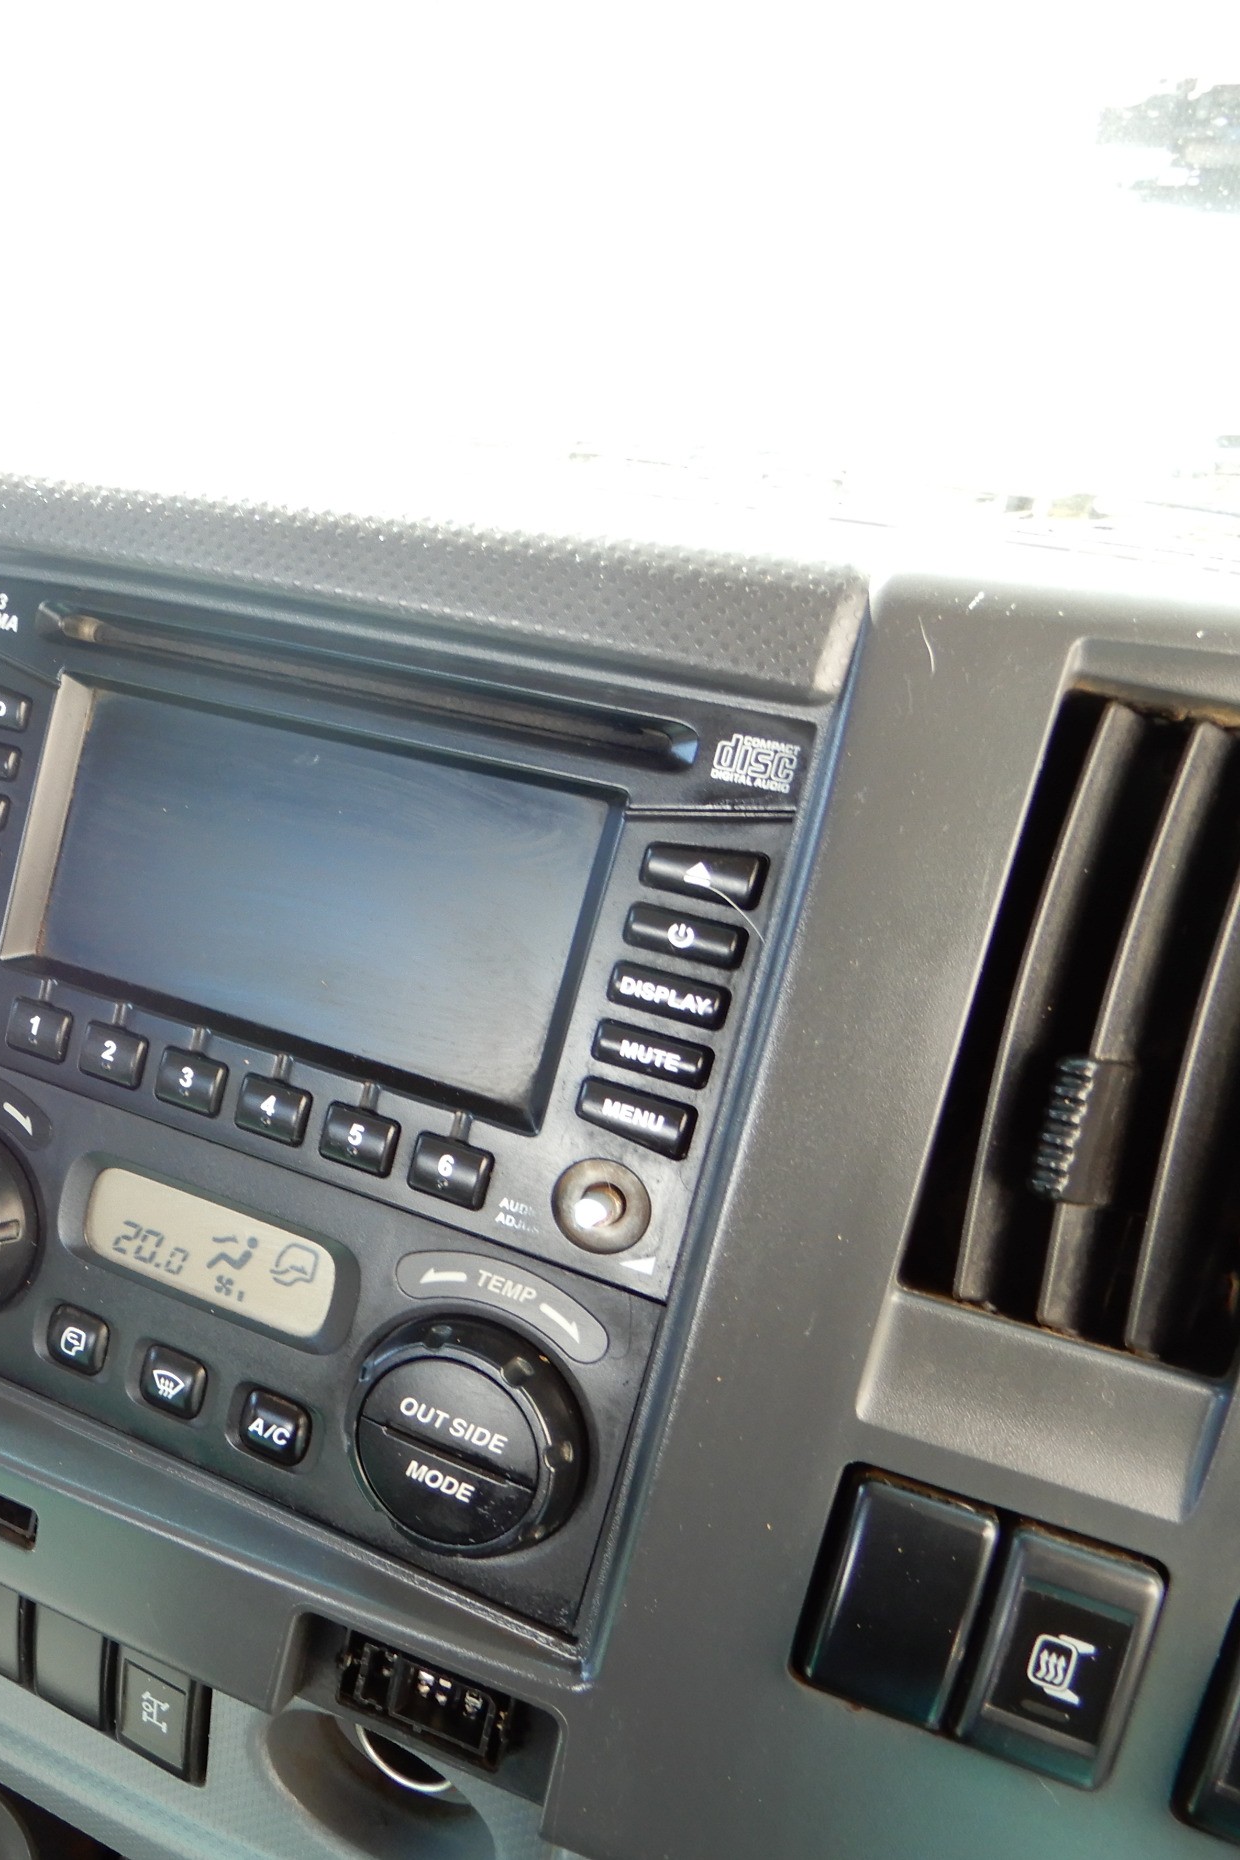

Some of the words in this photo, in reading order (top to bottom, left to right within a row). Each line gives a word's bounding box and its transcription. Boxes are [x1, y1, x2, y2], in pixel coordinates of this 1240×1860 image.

[744, 735, 801, 756] COMPACT
[710, 767, 753, 787] DIGITAL
[753, 778, 791, 794] AUDIO
[619, 976, 713, 1015] DISPLAY
[29, 1015, 41, 1036] 1
[101, 1040, 117, 1062] 2
[619, 1039, 681, 1072] MUTE
[179, 1066, 194, 1088] 3
[260, 1095, 276, 1116] 4
[602, 1097, 664, 1132] MENU
[347, 1123, 365, 1145] 5
[437, 1154, 455, 1177] 6
[112, 1220, 190, 1275] 20.0
[477, 1269, 537, 1302] TEMP
[248, 1417, 291, 1446] A/C
[399, 1397, 451, 1429] OUT
[448, 1417, 509, 1455] SIDE
[405, 1459, 476, 1504] MODE
